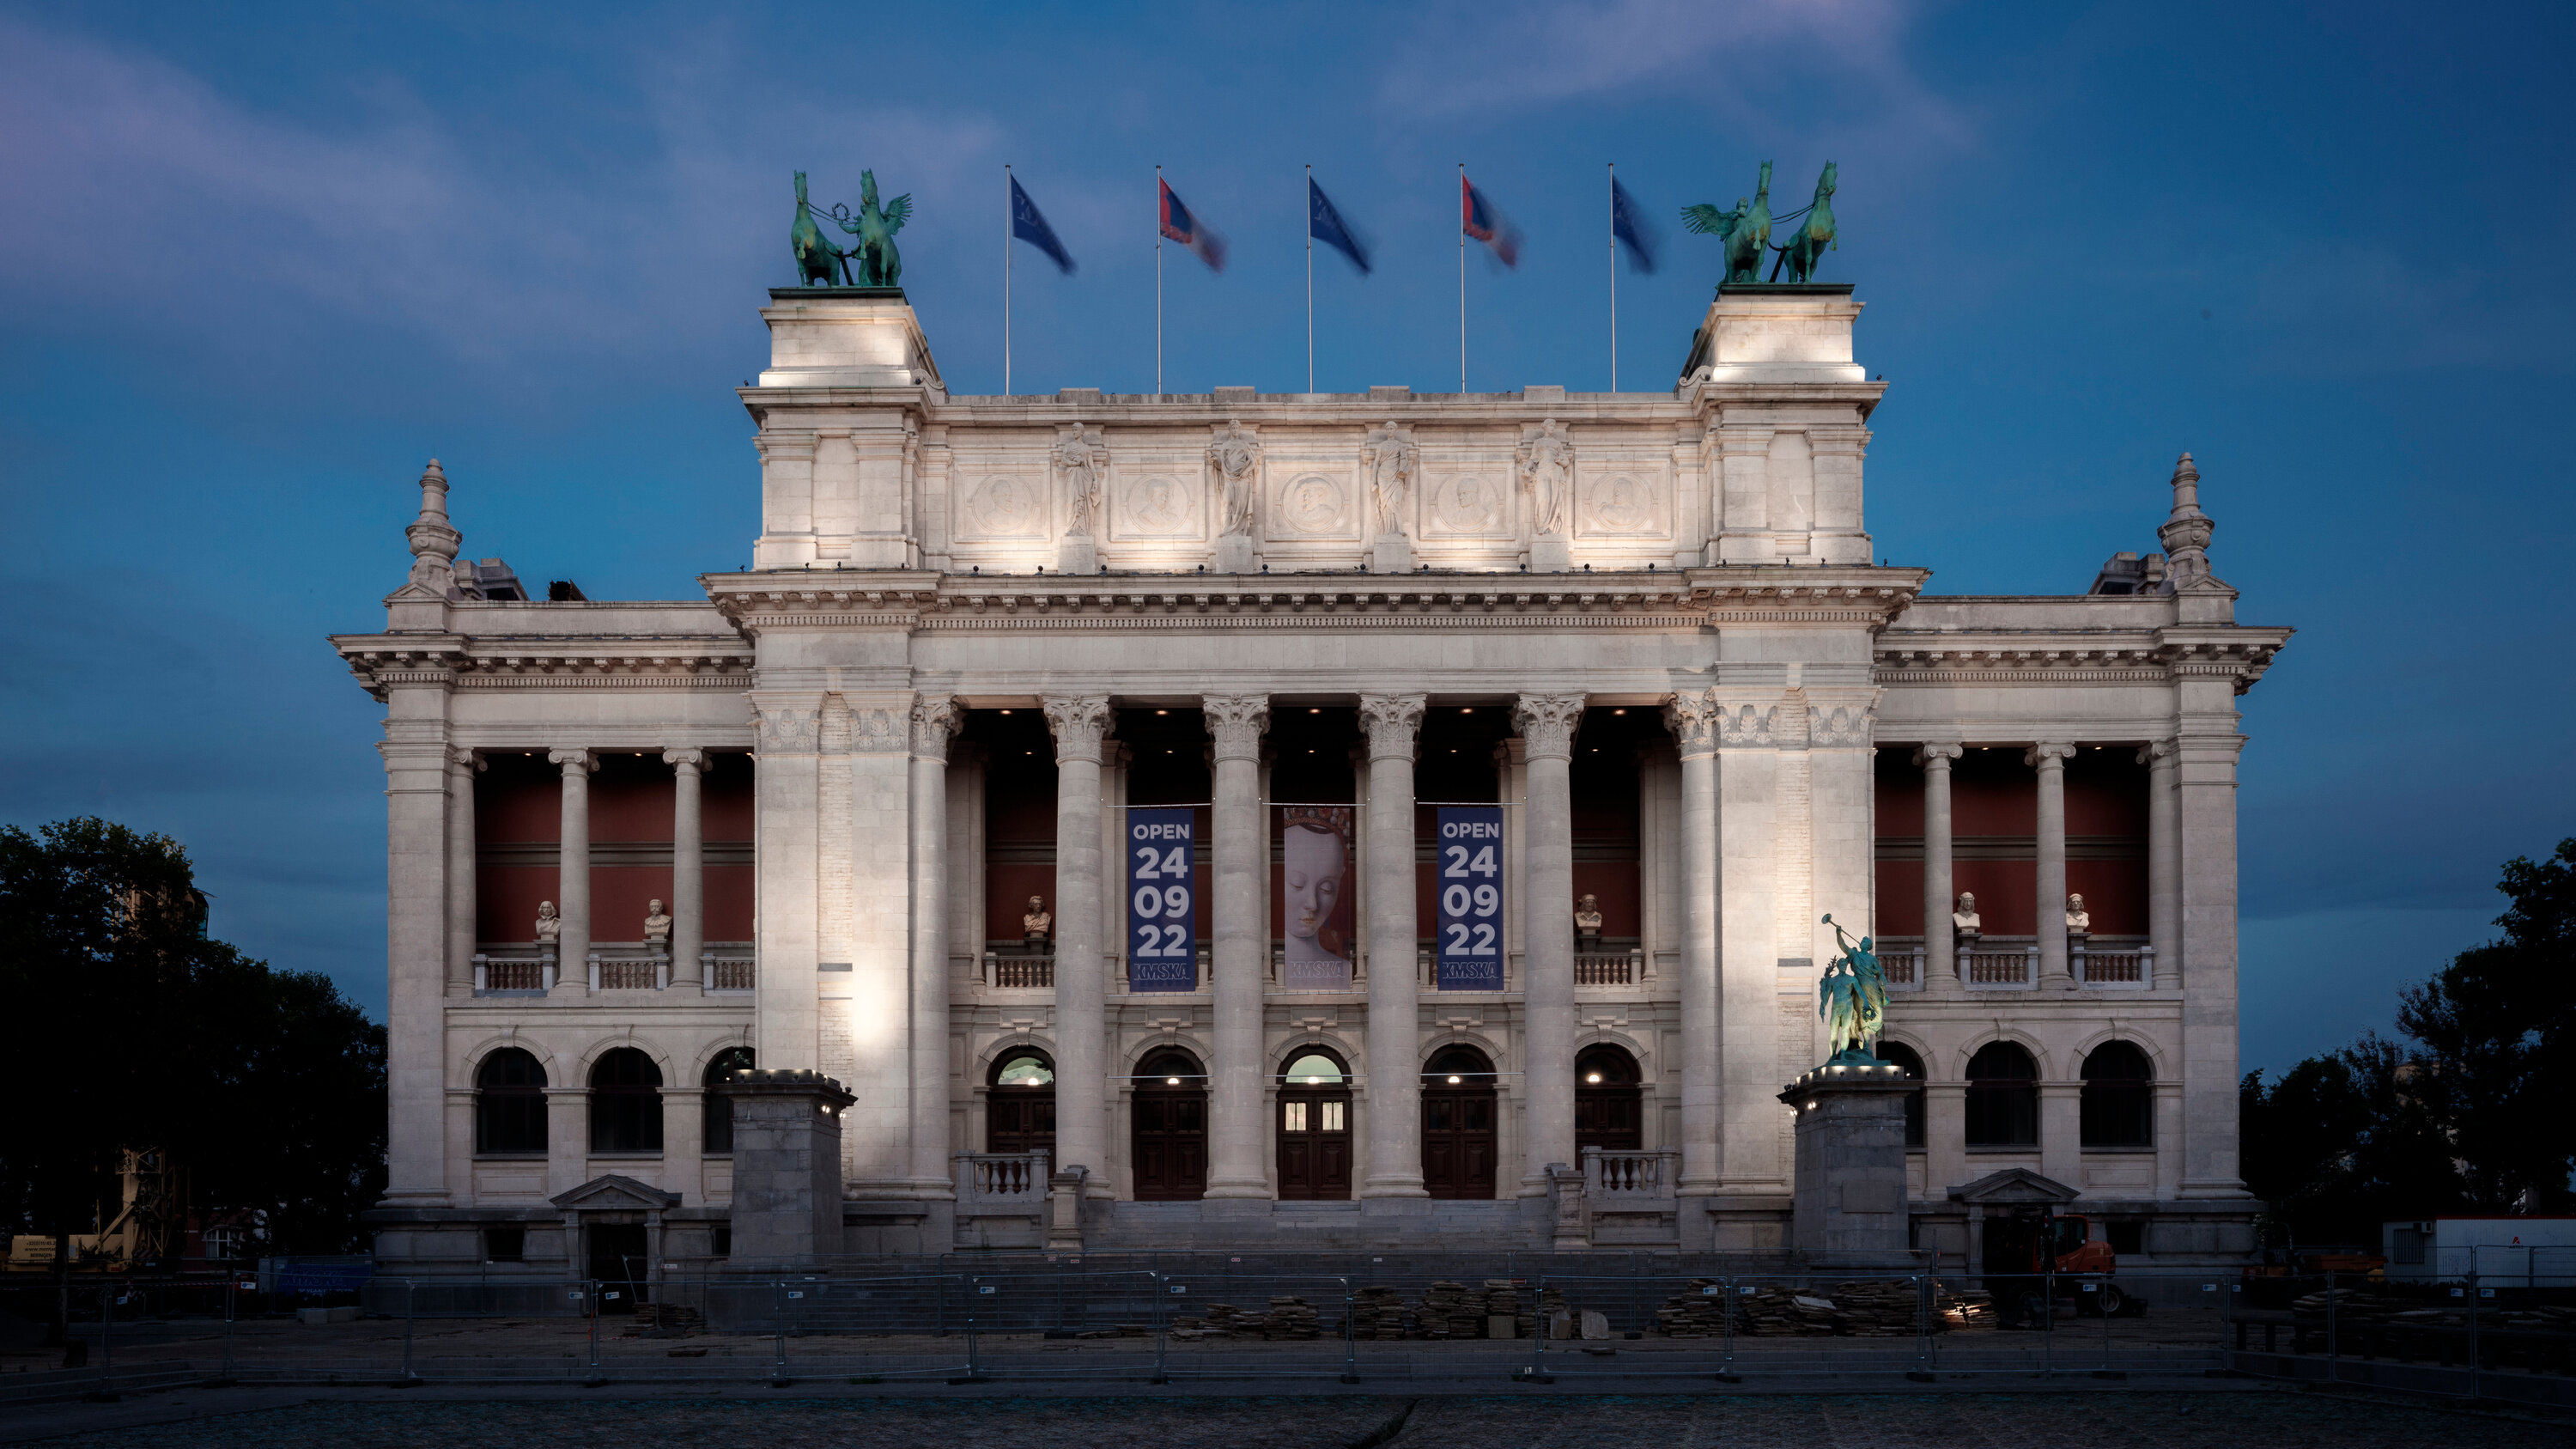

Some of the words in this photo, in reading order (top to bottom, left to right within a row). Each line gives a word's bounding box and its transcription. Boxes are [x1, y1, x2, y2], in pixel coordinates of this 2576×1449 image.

[1133, 824, 1190, 840] OPEN
[1443, 822, 1499, 838] OPEN
[1135, 846, 1188, 880] 24
[1444, 845, 1498, 878] 24
[1133, 885, 1190, 919] 09
[1443, 884, 1498, 917] 09
[1137, 924, 1188, 957] 22
[1445, 922, 1496, 956] 22
[1133, 962, 1191, 981] KMSKA
[1289, 960, 1346, 978] KMSKA
[1442, 961, 1500, 979] KMSKA
